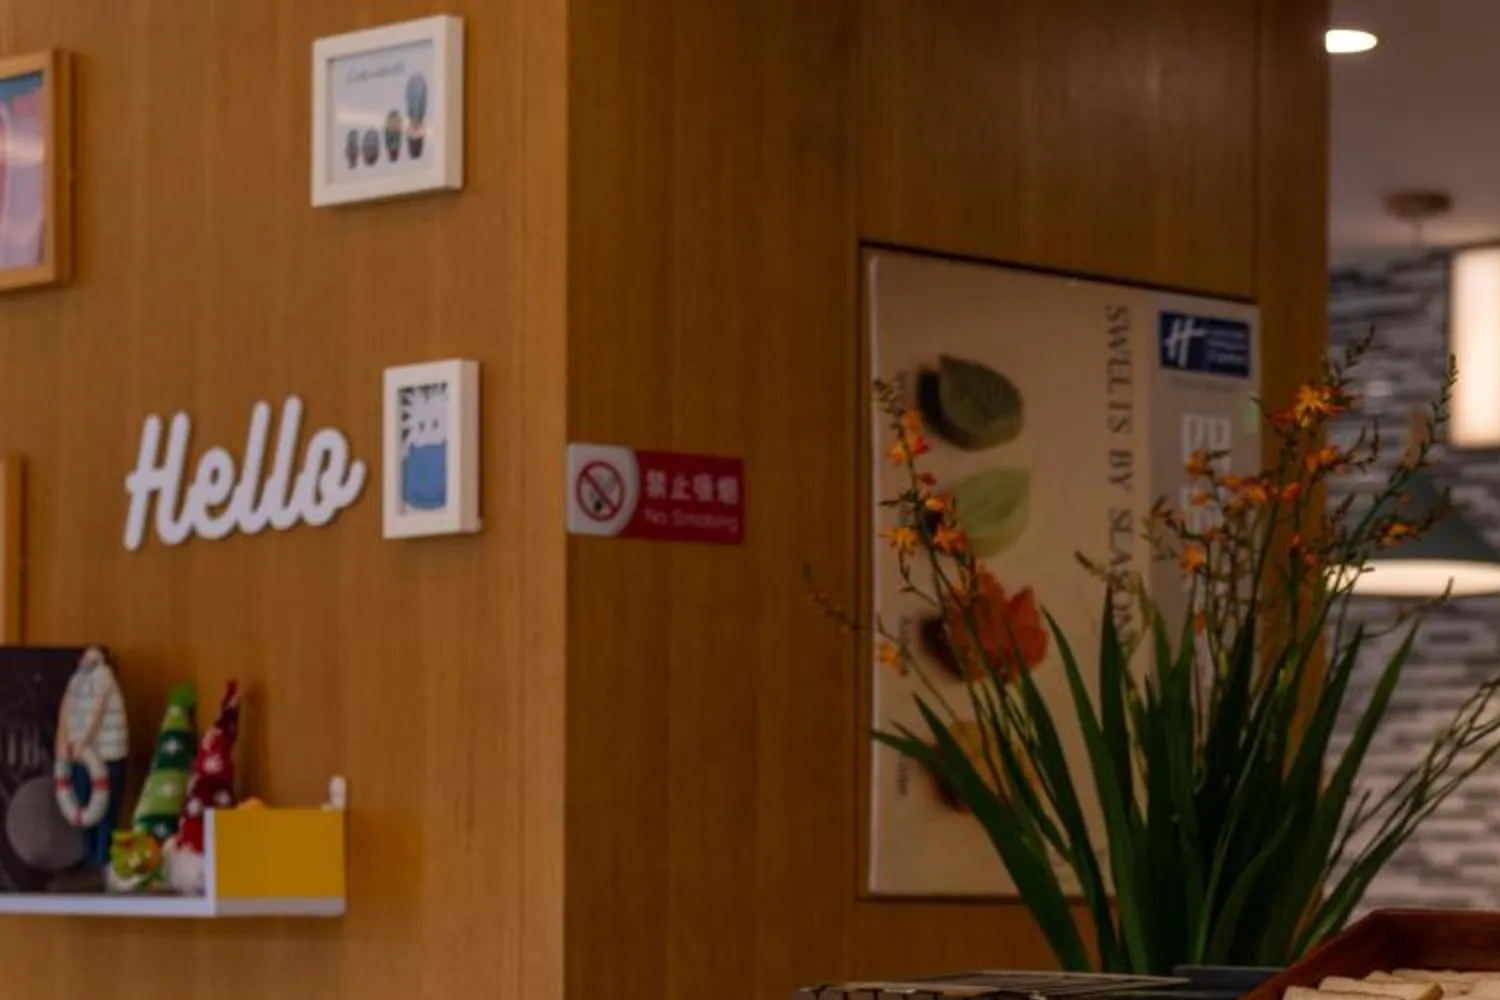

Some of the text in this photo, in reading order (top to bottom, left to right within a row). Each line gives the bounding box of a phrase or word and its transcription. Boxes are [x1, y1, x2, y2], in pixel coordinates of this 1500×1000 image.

[124, 394, 367, 551] Hello
[1109, 449, 1133, 492] BY
[644, 508, 668, 526] No
